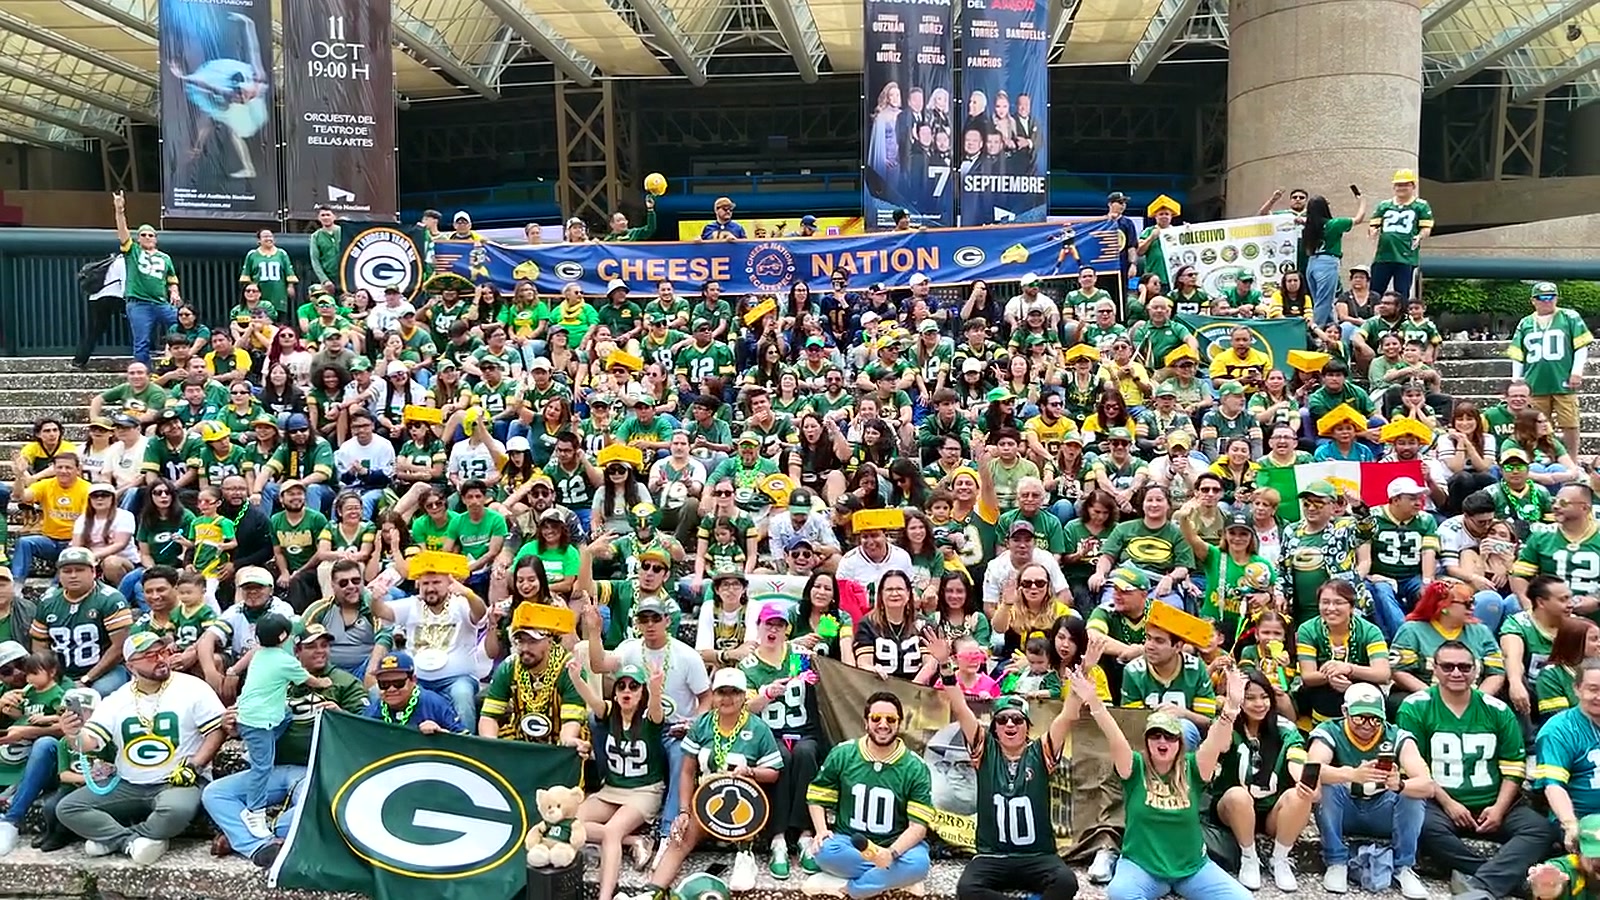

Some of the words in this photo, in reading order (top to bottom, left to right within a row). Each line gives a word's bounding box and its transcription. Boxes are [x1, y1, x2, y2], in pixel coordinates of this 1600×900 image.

[967, 0, 986, 9] DEL
[329, 15, 344, 40] 11
[970, 27, 1000, 38] TORRES
[311, 41, 365, 60] OCT
[876, 51, 901, 63] MUÑIZ
[917, 53, 946, 66] CUEVAS
[307, 60, 347, 79] 19:00
[351, 64, 370, 80] H
[967, 56, 1003, 69] PANCHOS
[304, 112, 356, 125] ORQUESTA
[357, 115, 376, 125] DEL
[313, 124, 353, 136] TEATRO
[355, 126, 368, 136] DE
[307, 135, 342, 147] BELLAS
[342, 136, 374, 148] ARTES
[928, 166, 951, 197] 7
[964, 175, 1045, 194] SEPTIEMBRE
[343, 204, 371, 212] Nacional
[1383, 209, 1416, 234] 23
[1179, 228, 1226, 246] COLECTIVO
[137, 254, 165, 280] 52
[258, 261, 281, 282] 10
[596, 257, 731, 282] CHEESE
[811, 247, 940, 278] NATION
[1523, 329, 1565, 362] 50
[652, 350, 674, 371] 18
[689, 357, 715, 384] 12
[480, 394, 506, 413] 12
[585, 434, 605, 450] 10
[459, 460, 489, 480] 12
[556, 475, 590, 504] 12
[1377, 531, 1422, 566] 33
[1552, 550, 1600, 595] 12
[49, 623, 101, 667] 88
[875, 637, 922, 675] 92
[520, 713, 552, 737] G
[130, 739, 171, 762] G
[605, 734, 649, 777] 52
[1429, 731, 1498, 789] 87
[343, 761, 513, 868] G
[850, 783, 896, 834] 10
[993, 792, 1036, 846] 10
